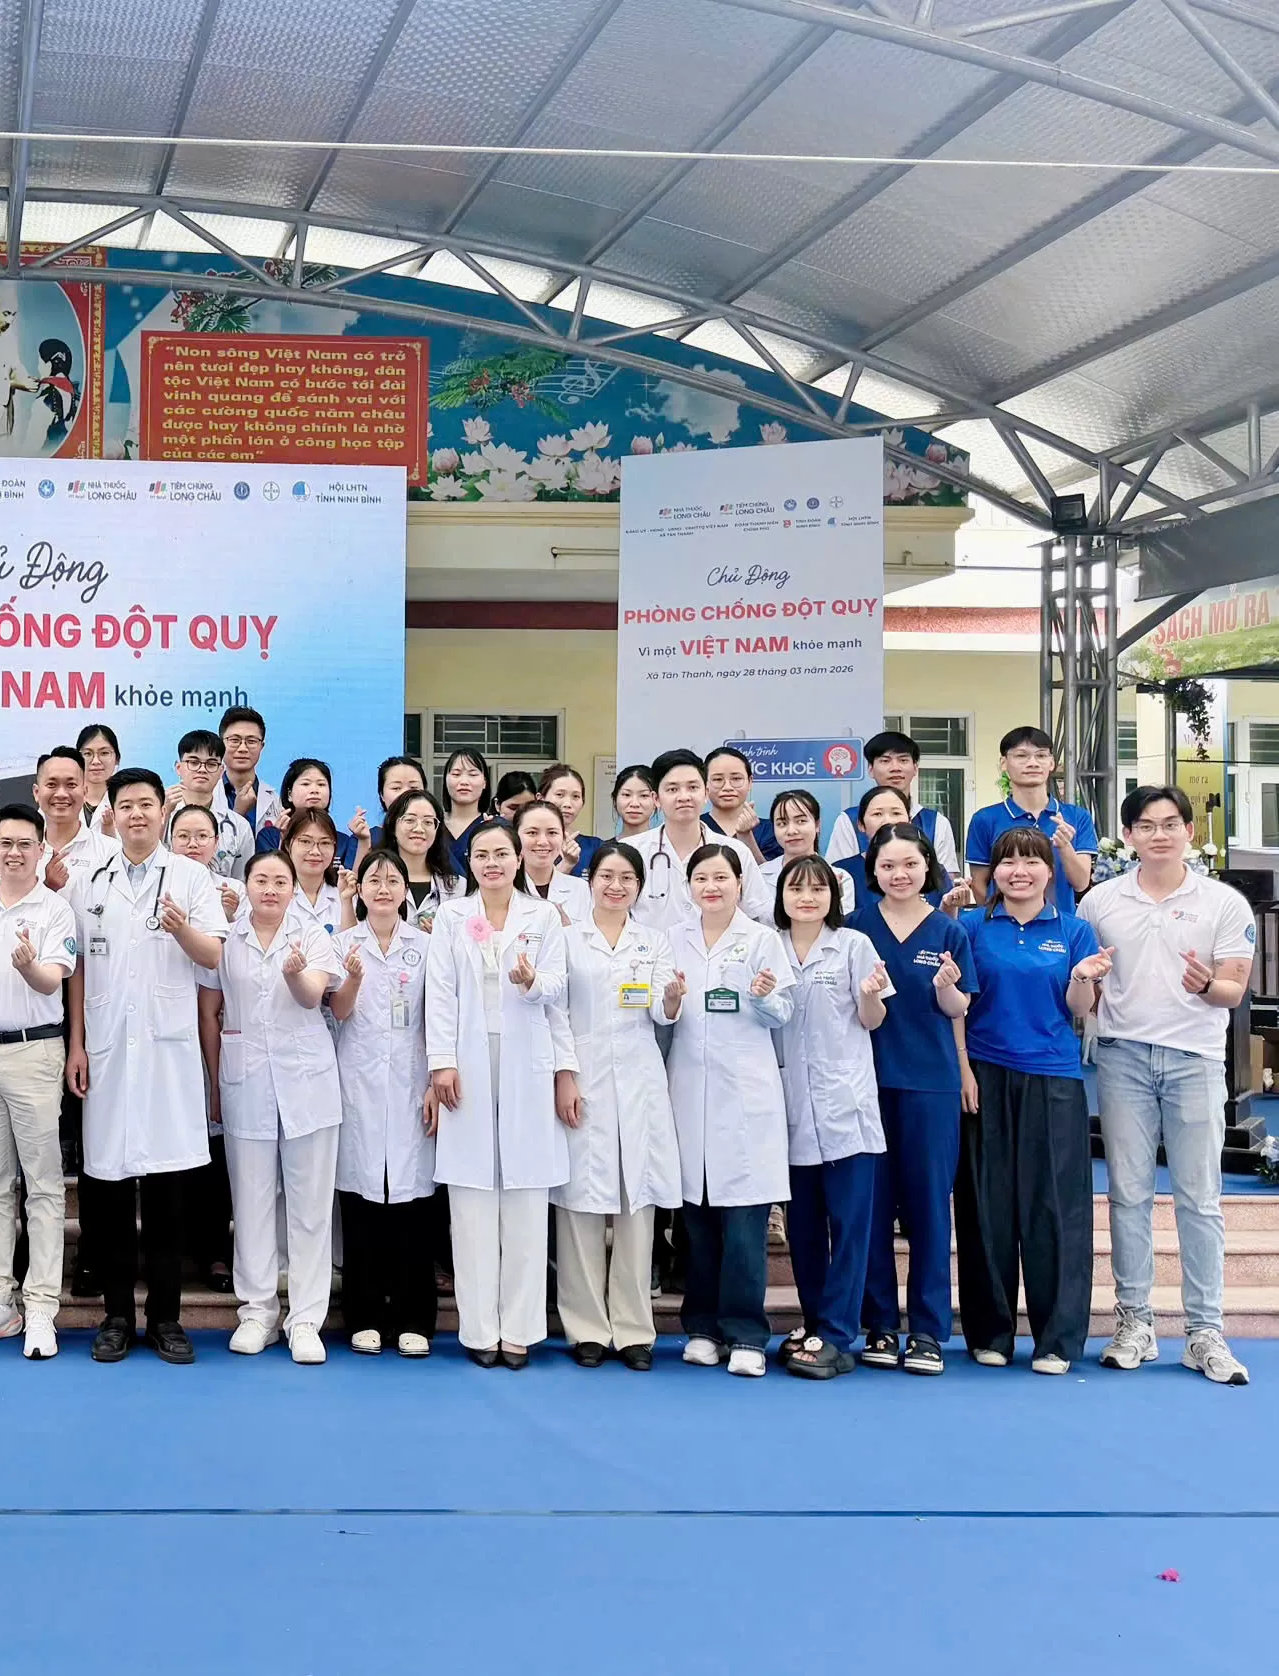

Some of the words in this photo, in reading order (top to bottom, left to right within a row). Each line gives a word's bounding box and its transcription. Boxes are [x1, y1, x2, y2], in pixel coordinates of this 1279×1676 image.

[217, 348, 260, 360] sông
[265, 348, 301, 362] Việt
[306, 350, 347, 360] Nam
[353, 350, 374, 361] có
[381, 350, 406, 361] trở
[164, 361, 194, 371] nên
[200, 362, 233, 372] tươi
[239, 362, 269, 375] đẹp
[275, 363, 305, 376] hay
[311, 364, 369, 377] không,
[374, 365, 406, 376] dân
[164, 375, 191, 388] tộc
[196, 376, 230, 389] Việt
[235, 377, 274, 388] Nam
[280, 378, 300, 388] có
[305, 378, 347, 389] bước
[352, 379, 374, 390] tới
[380, 380, 406, 390] đài
[163, 405, 196, 415] các
[202, 406, 258, 418] cường
[264, 406, 309, 418] quốc
[315, 408, 355, 418] năm
[361, 409, 405, 419] châu
[162, 434, 196, 447] một
[201, 434, 242, 446] phần
[248, 436, 274, 446] lớn
[279, 435, 289, 446] ở
[295, 437, 336, 449] công
[341, 437, 372, 450] học
[377, 438, 404, 451] tập
[162, 447, 193, 458] của
[197, 449, 225, 459] các
[1, 478, 26, 488] ĐOÀN
[87, 480, 101, 489] NHÀ
[103, 480, 126, 489] THUỐC
[170, 481, 186, 490] TIÊM
[329, 482, 344, 493] HỘI
[346, 483, 368, 492] LHTN
[4, 489, 24, 499] BÌNH
[87, 491, 112, 501] LONG
[113, 490, 137, 501] CHÂU
[170, 492, 195, 501] LONG
[196, 491, 222, 502] CHÂU
[337, 494, 359, 504] NINH
[361, 493, 382, 504] BÌNH
[19, 541, 109, 604] Động
[707, 565, 742, 586] Chủ
[744, 564, 791, 589] Động
[624, 604, 696, 624] PHÒNG
[701, 597, 777, 620] CHỐNG
[781, 597, 826, 620] ĐỘT
[831, 598, 878, 617] QUỴ
[1244, 591, 1271, 627] RA
[91, 604, 177, 659] ĐỘT
[188, 614, 278, 661] QUỴ
[638, 647, 650, 656] Vì
[653, 646, 676, 658] một
[679, 634, 730, 659] VIỆT
[735, 635, 789, 653] NAM
[793, 639, 823, 650] khỏe
[827, 638, 862, 651] mạnh
[0, 670, 105, 709] NAM
[115, 683, 173, 707] khỏe
[181, 685, 248, 712] mạnh
[771, 757, 815, 776] KHOẺ
